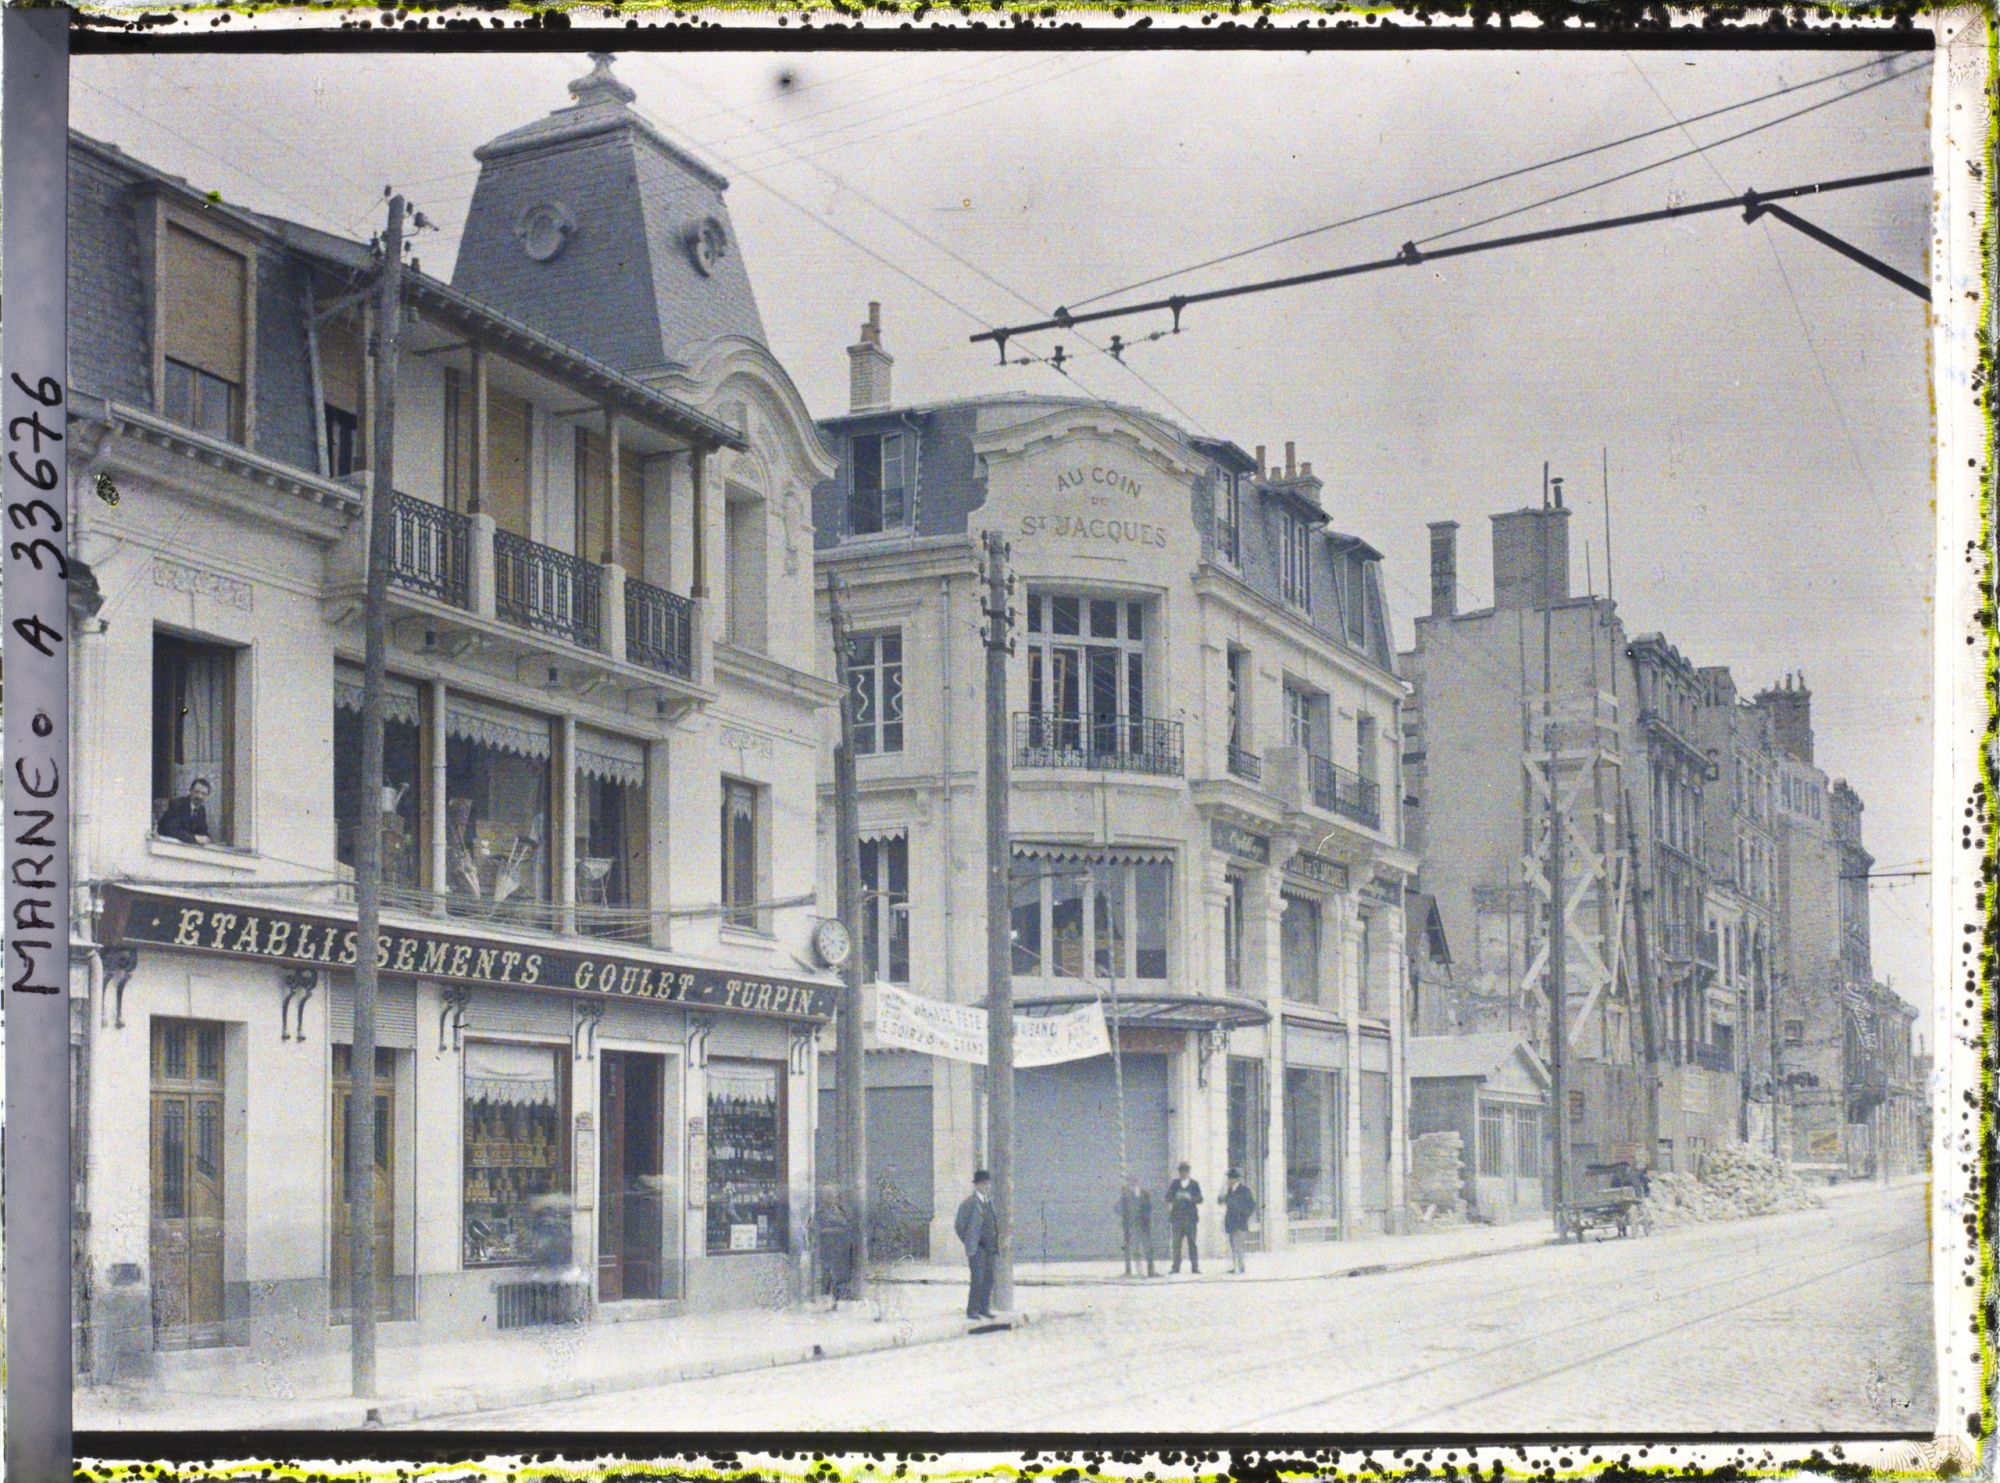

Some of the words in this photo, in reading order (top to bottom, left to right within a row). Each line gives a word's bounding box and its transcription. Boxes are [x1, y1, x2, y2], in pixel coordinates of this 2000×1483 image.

[8, 372, 68, 579] 33676
[1057, 468, 1084, 492] AU
[1091, 467, 1142, 499] COIN
[1055, 515, 1167, 549] JACQUES
[13, 614, 63, 657] A
[12, 757, 60, 995] MARNE
[174, 907, 543, 985] ETABLISSEMENTS
[574, 960, 695, 1002] GOULET
[724, 978, 814, 1016] TURPIN
